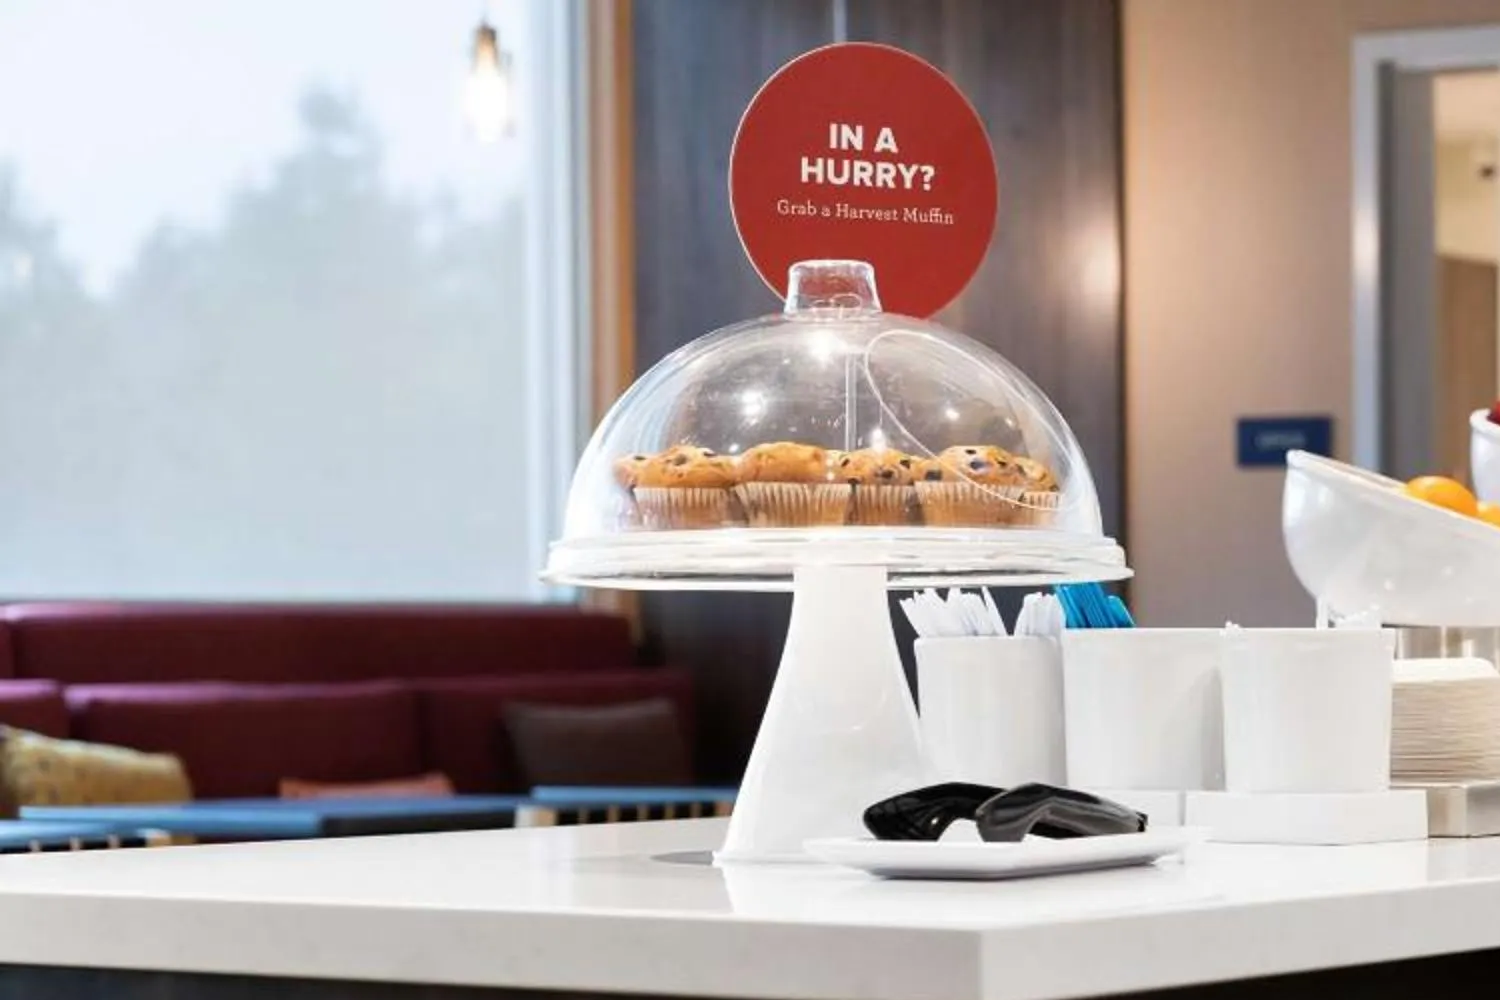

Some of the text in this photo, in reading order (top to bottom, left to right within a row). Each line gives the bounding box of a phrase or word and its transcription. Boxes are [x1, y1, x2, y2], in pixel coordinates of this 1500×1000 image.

[829, 123, 899, 153] IN A
[800, 156, 935, 191] HURRY?
[777, 199, 954, 225] Grab a Harvest Muffin
